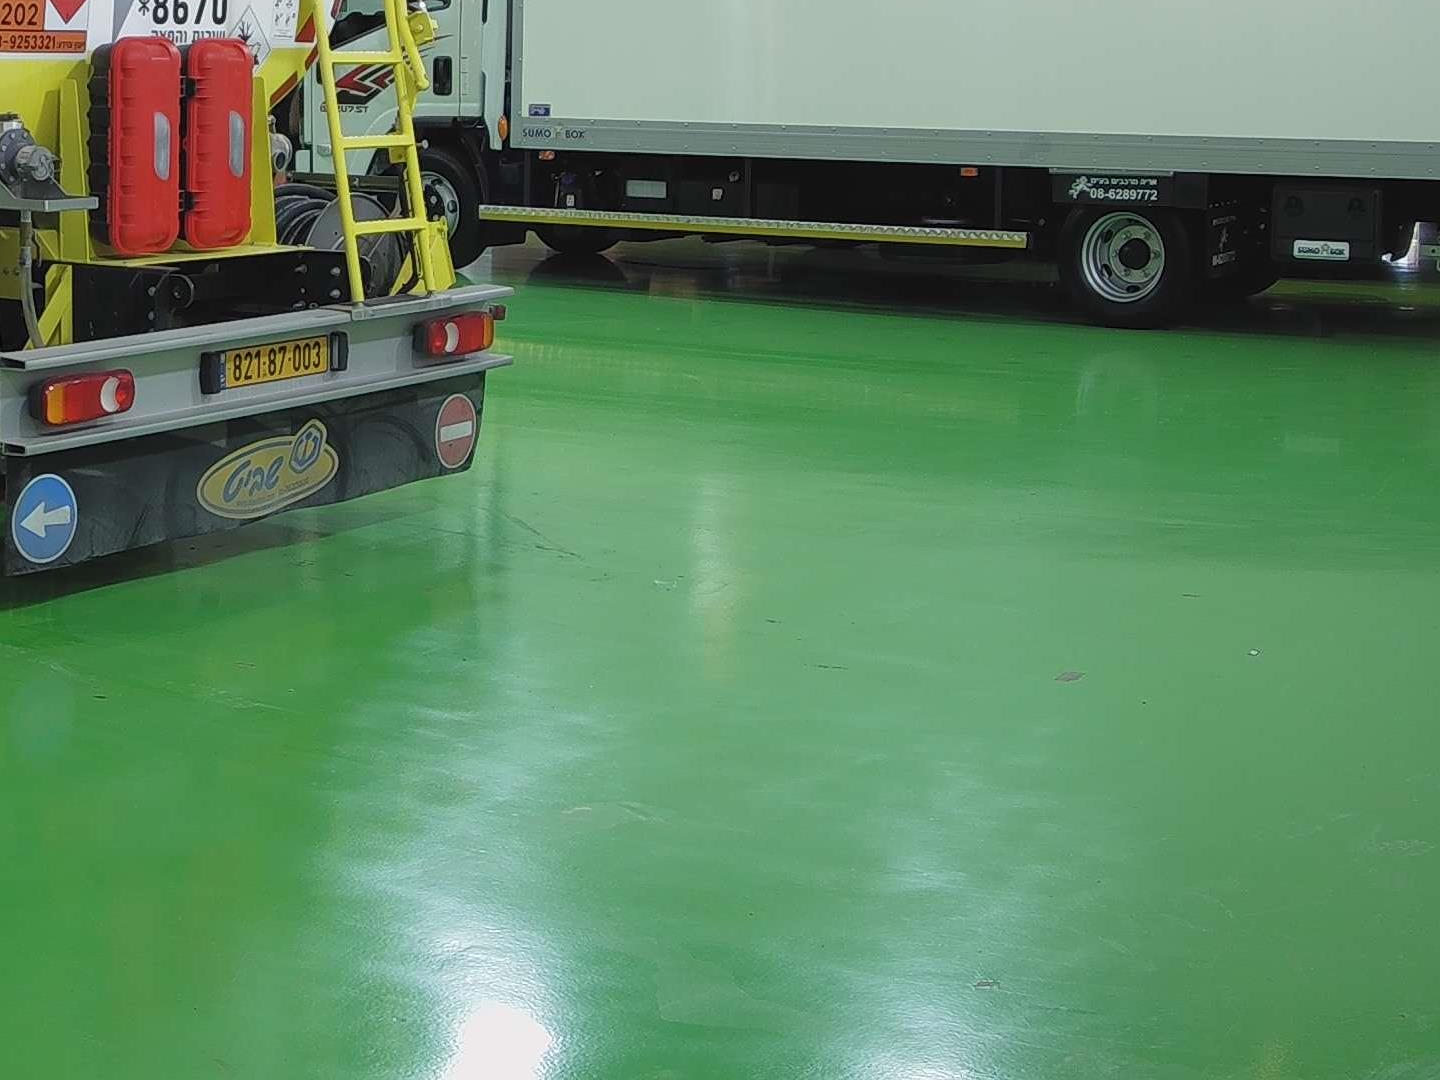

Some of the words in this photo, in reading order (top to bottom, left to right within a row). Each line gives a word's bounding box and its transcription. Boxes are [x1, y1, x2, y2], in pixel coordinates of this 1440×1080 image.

[523, 128, 551, 138] SUMO
[565, 129, 585, 139] BOX
[1090, 188, 1158, 200] 08-6289772
